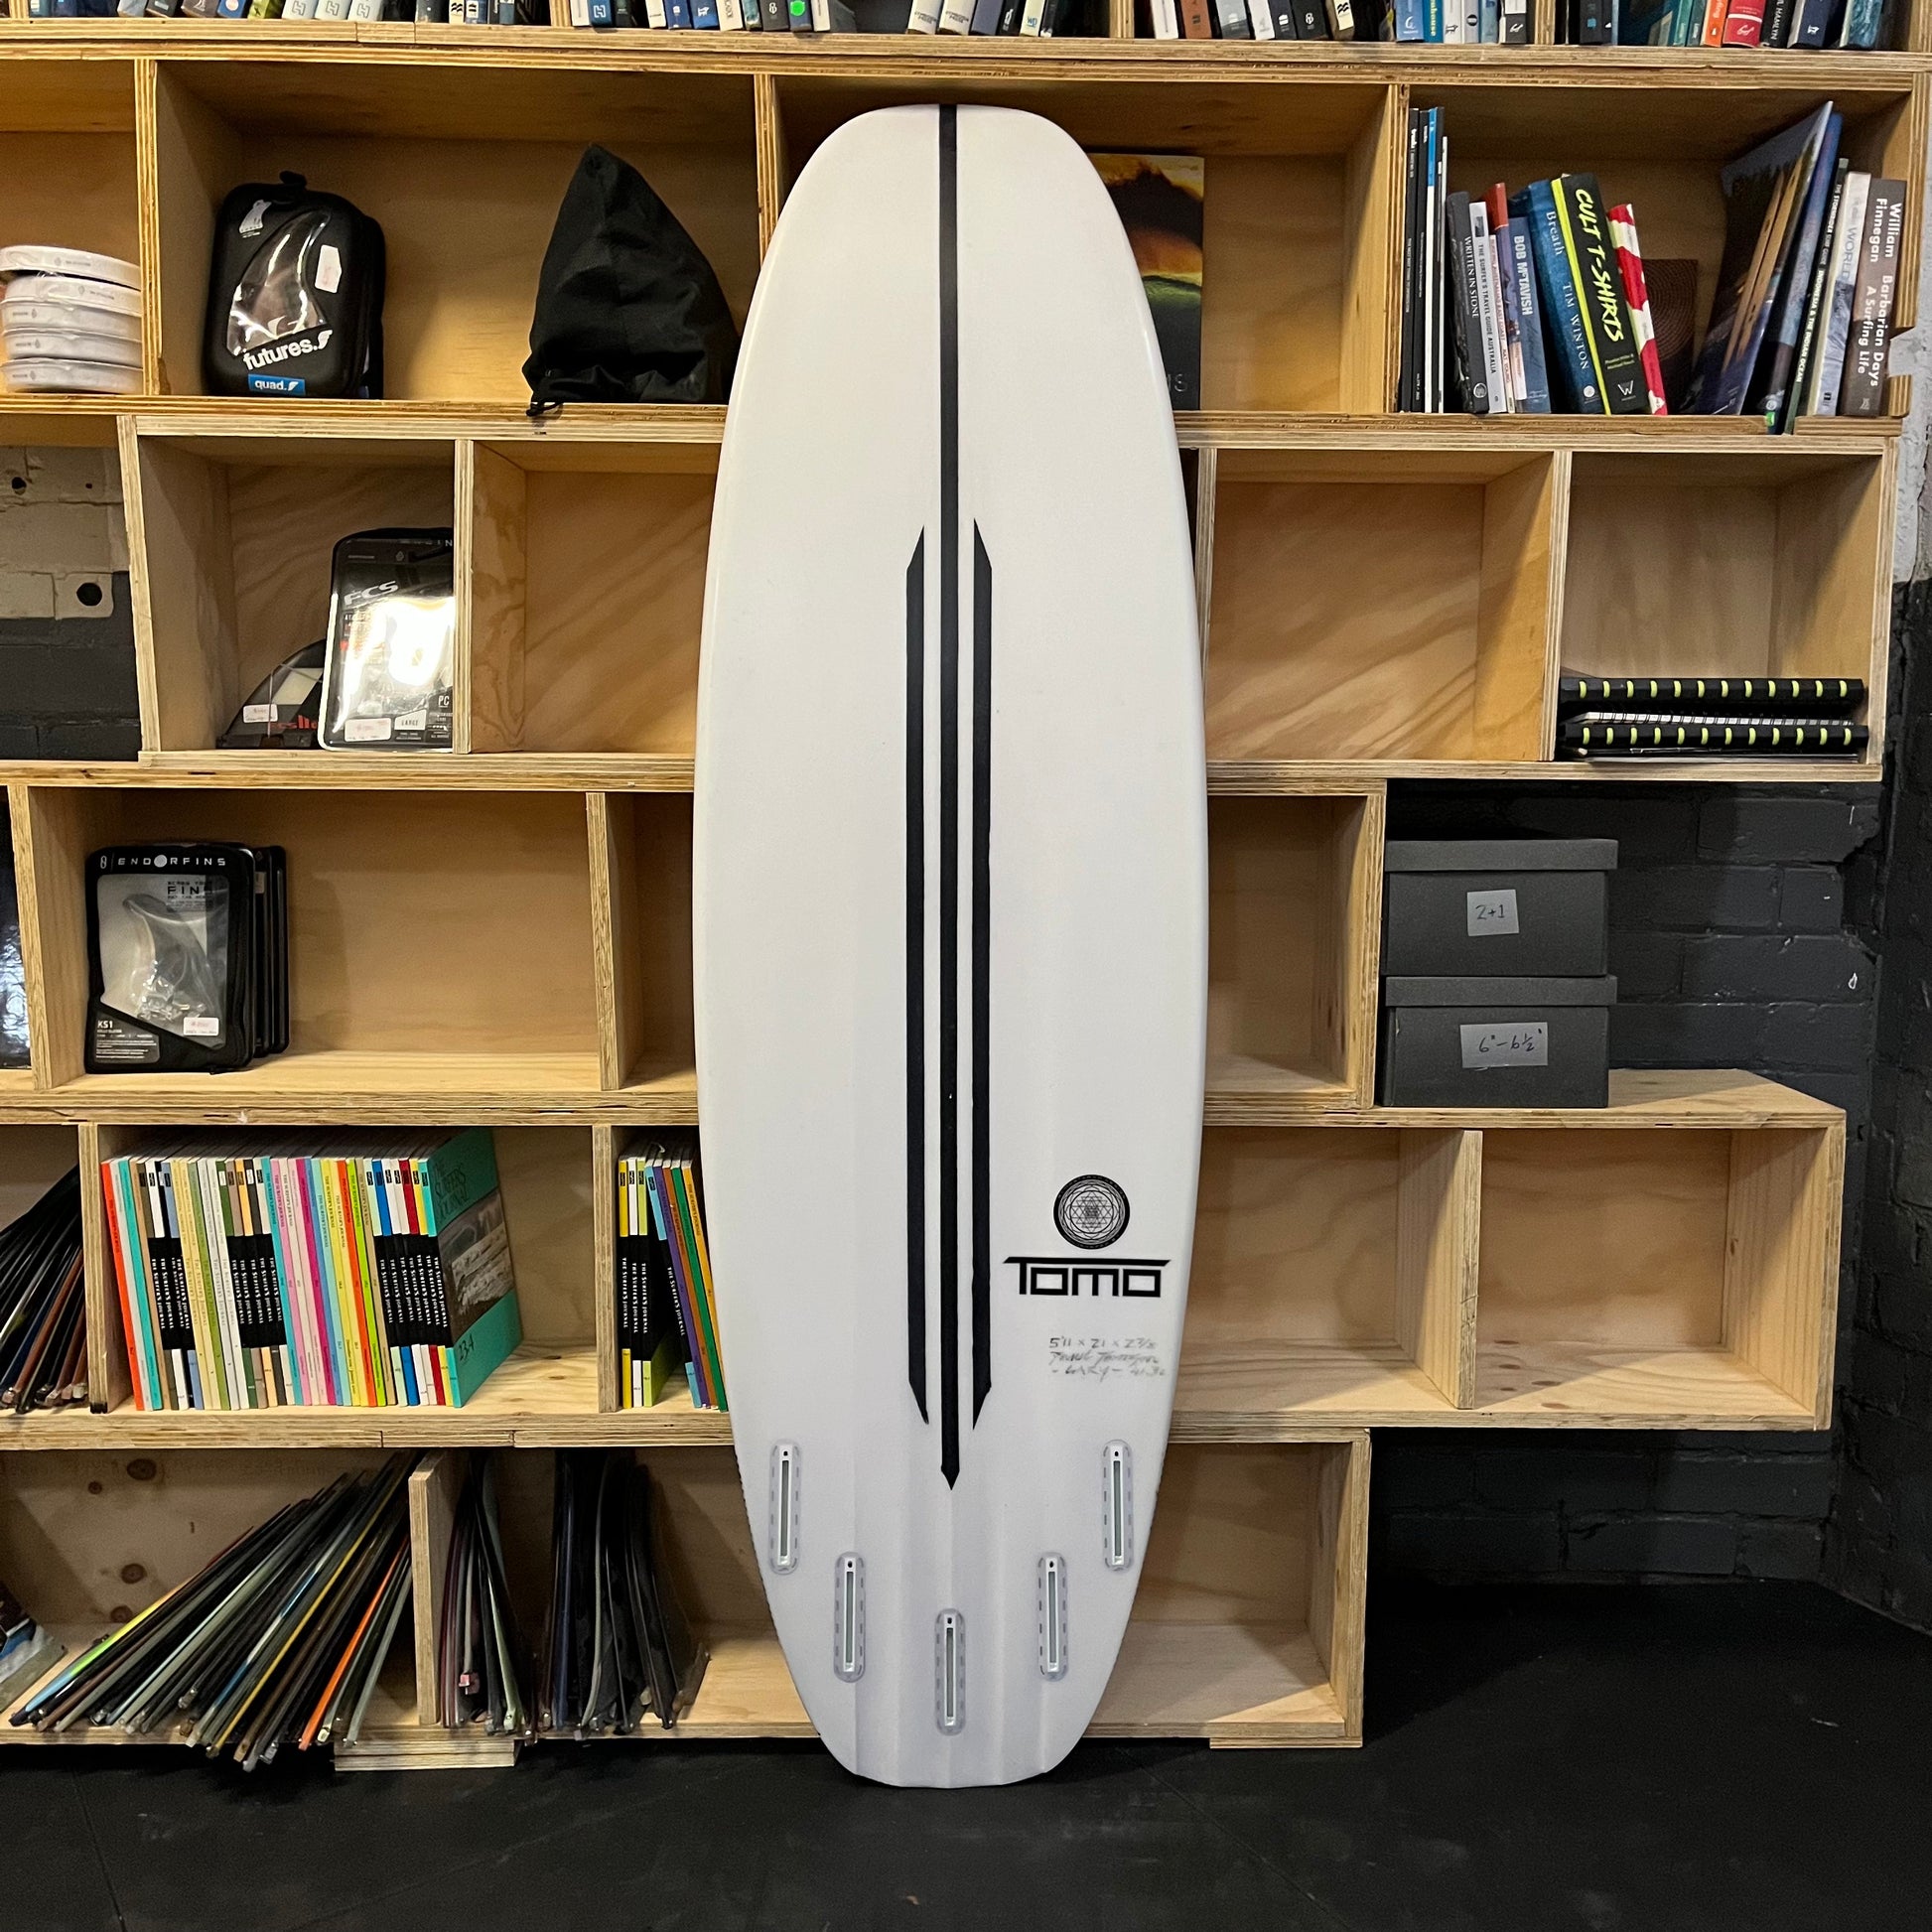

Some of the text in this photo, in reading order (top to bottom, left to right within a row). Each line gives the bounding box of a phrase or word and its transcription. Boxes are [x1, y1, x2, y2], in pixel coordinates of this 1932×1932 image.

[1546, 210, 1565, 256] Breath
[1575, 189, 1602, 241] CULT
[1869, 199, 1888, 262] Finnegan
[1884, 203, 1902, 258] William
[1514, 235, 1527, 259] BOB
[1842, 227, 1858, 281] WORLD
[1464, 235, 1479, 318] WRITTEN IN STONE
[1587, 244, 1625, 343] T-SHIRTS
[1811, 269, 1824, 309] INDONESIA
[1563, 281, 1589, 369] TIM WINTON
[1800, 331, 1811, 356] INDIAN
[1858, 285, 1877, 374] A Surfing Life
[1868, 275, 1893, 387] Barbarian Days
[243, 337, 318, 370] futures.
[1487, 337, 1497, 373] AUSTRALIA
[1794, 357, 1806, 382] OCEAN
[254, 379, 288, 391] quad.
[344, 580, 399, 606] FCS
[438, 695, 450, 706] PC
[1474, 903, 1505, 920] 2+1
[97, 1020, 113, 1029] KS1
[1090, 1337, 1106, 1348] 21
